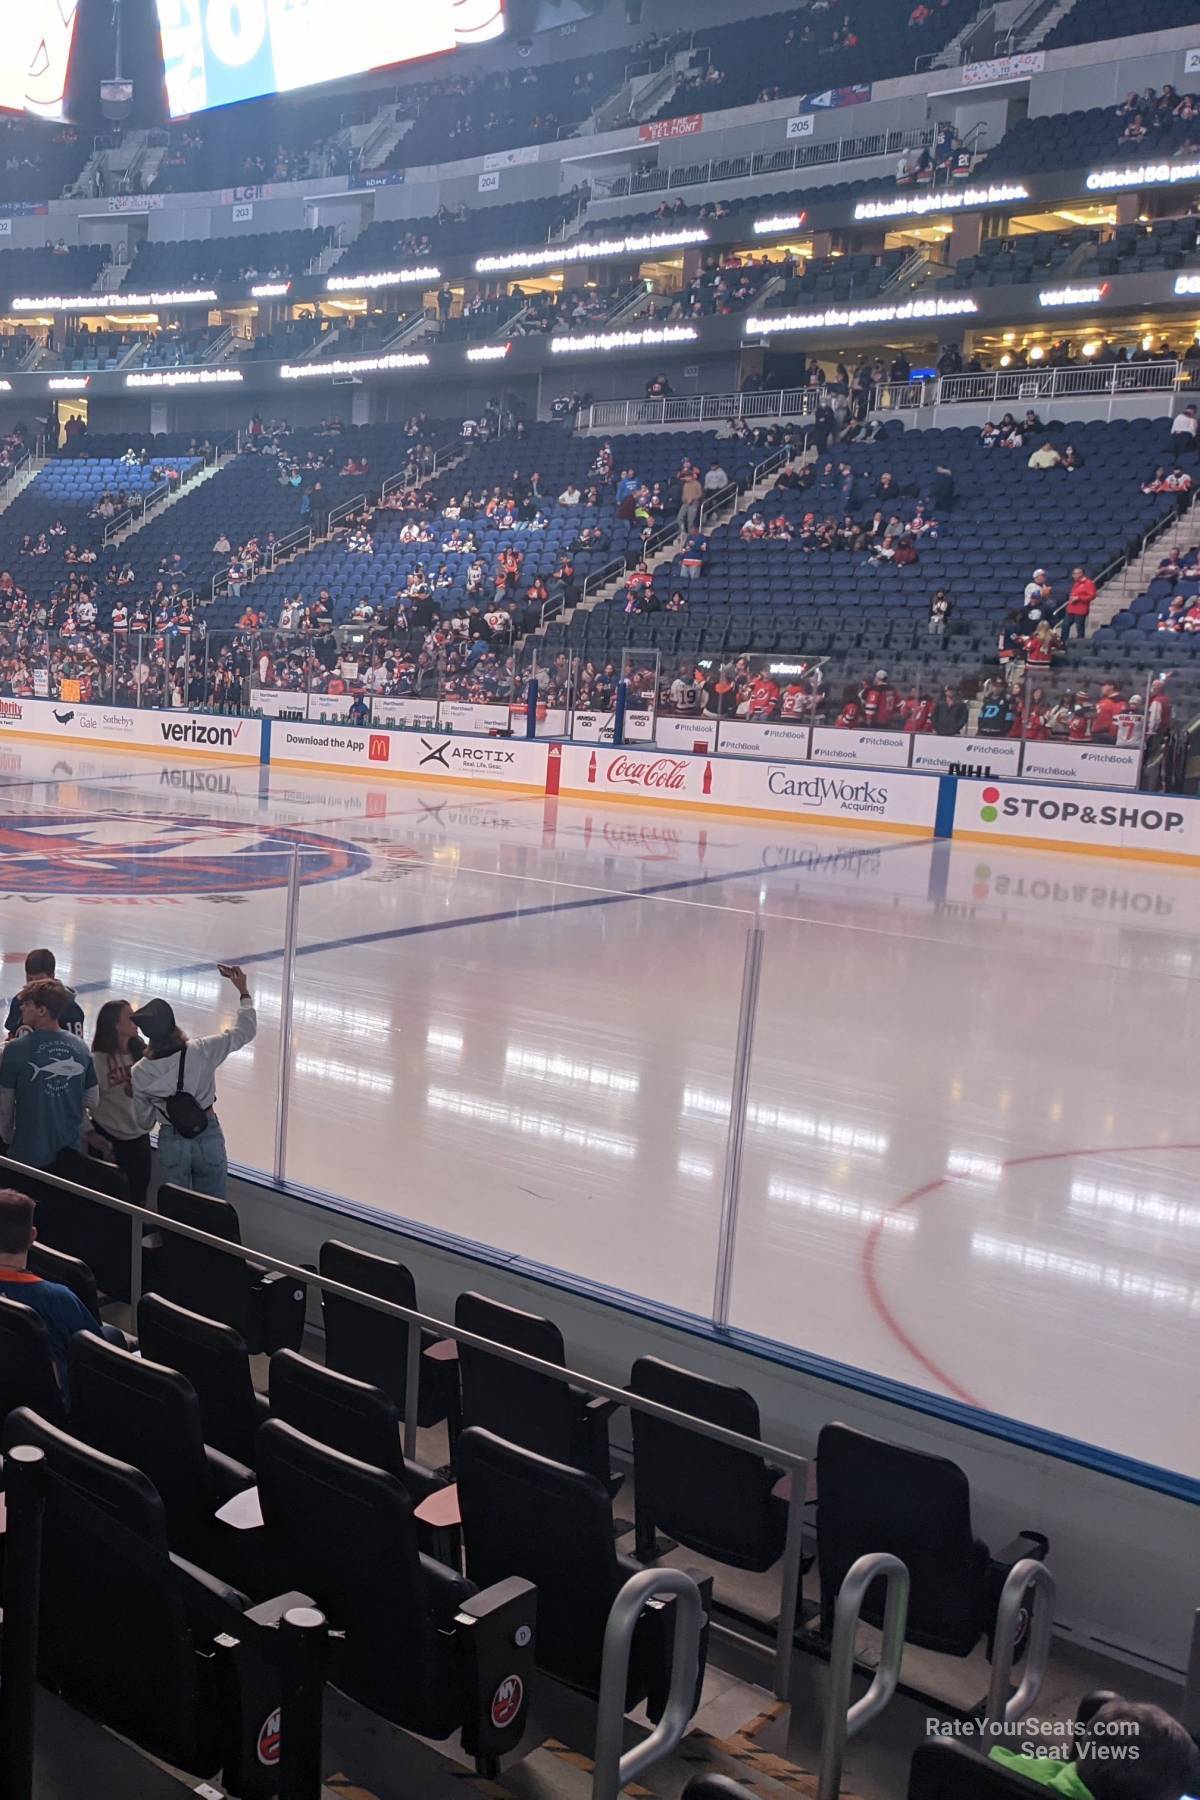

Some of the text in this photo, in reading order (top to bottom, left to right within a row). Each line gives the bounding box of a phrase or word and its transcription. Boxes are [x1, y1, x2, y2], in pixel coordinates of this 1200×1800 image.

[791, 120, 809, 133] 205
[481, 177, 496, 188] 204
[235, 208, 249, 218] 203
[753, 216, 799, 234] verizon
[1039, 286, 1100, 306] verizon
[680, 690, 696, 704] 19
[80, 716, 97, 728] Gale
[160, 720, 232, 746] verizon
[1122, 722, 1135, 741] 7
[286, 734, 365, 753] Download the App
[452, 747, 515, 763] ARCTIX
[1088, 753, 1133, 765] PitchBook
[606, 755, 691, 789] Coca-Cola
[1033, 765, 1077, 777] PitchBook
[768, 771, 888, 805] CardWorks
[840, 801, 885, 815] Acquiring
[1002, 796, 1184, 832] STOP&SHOP
